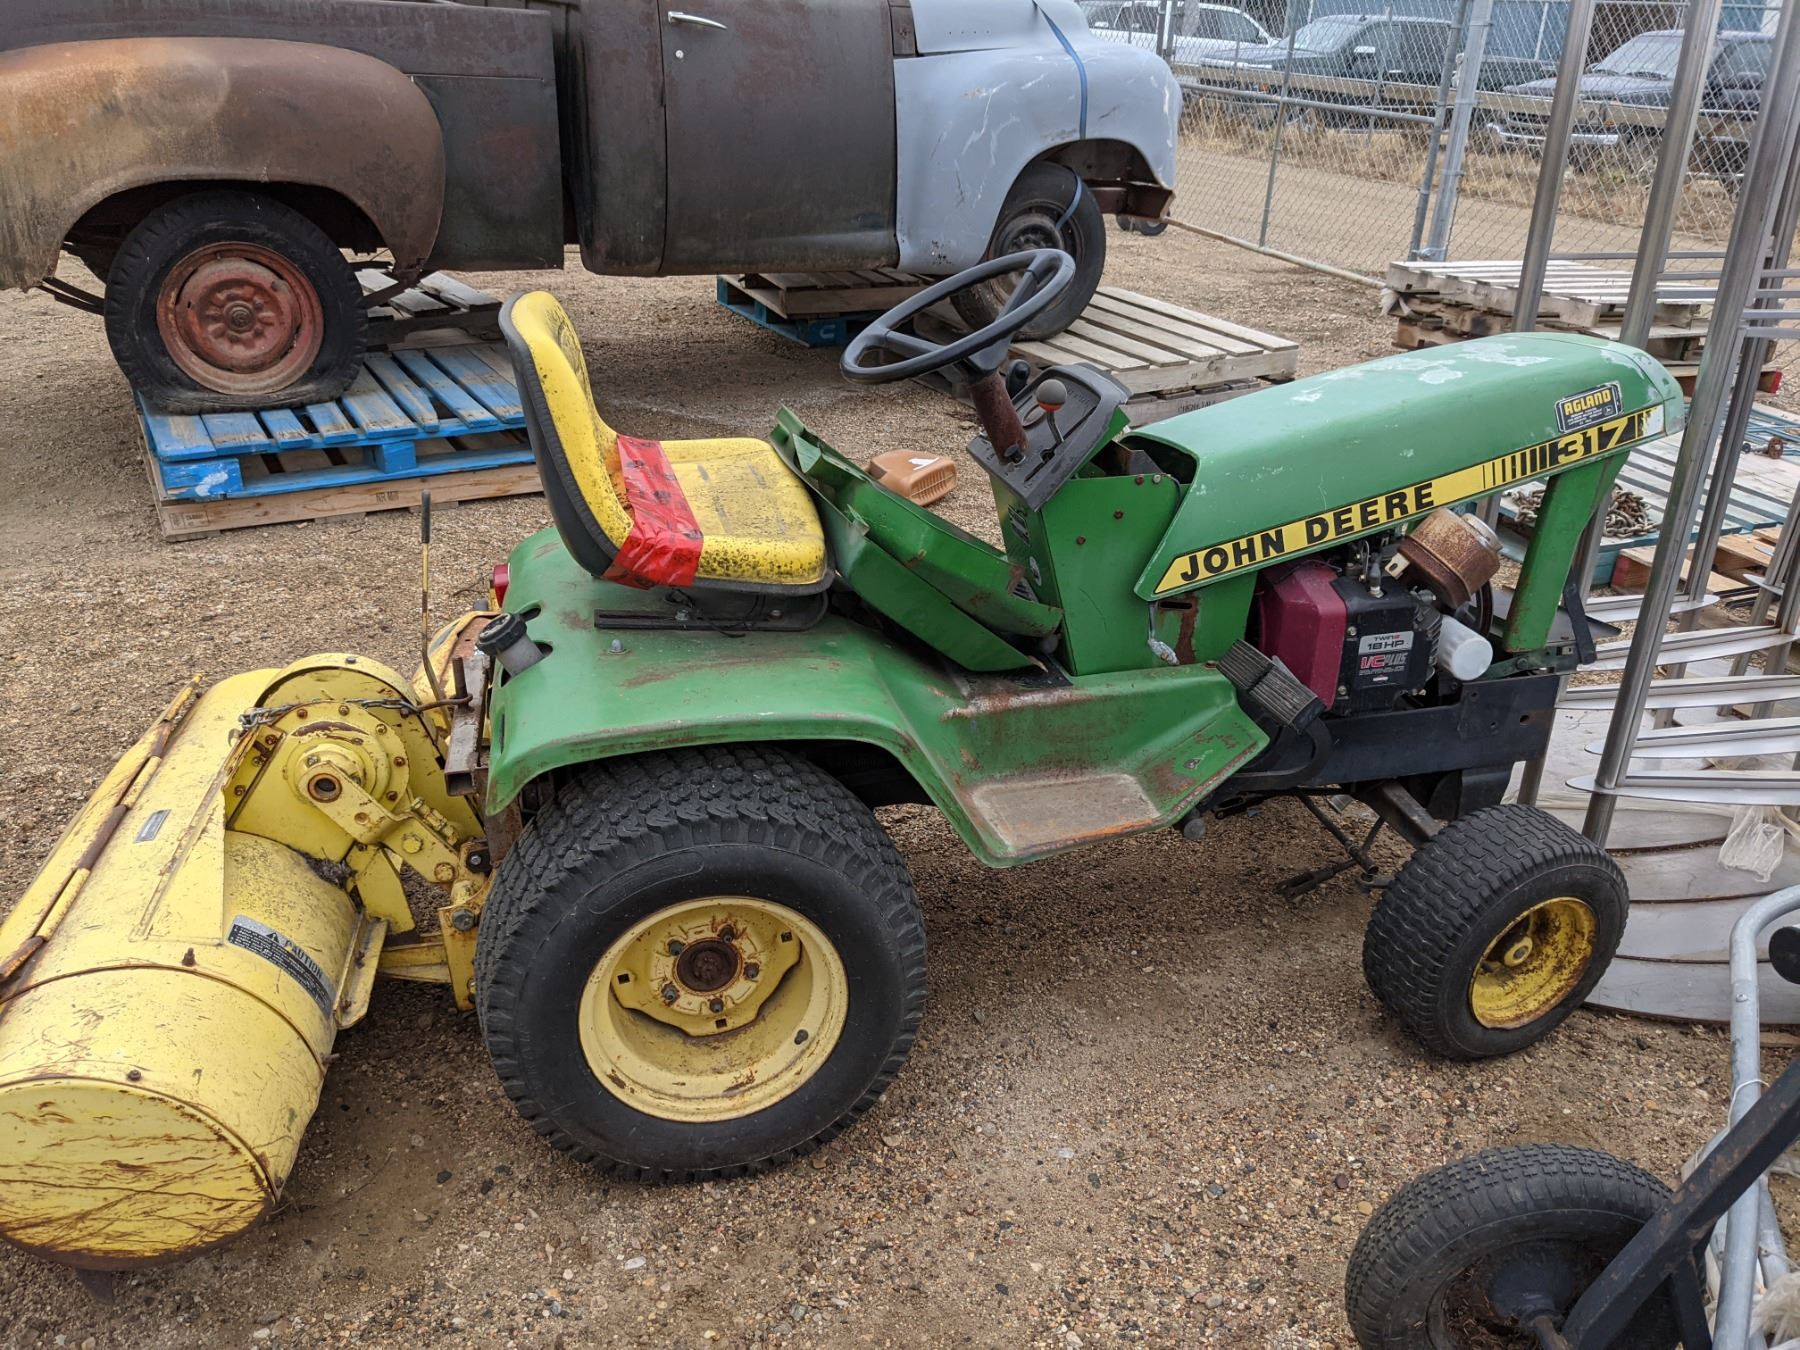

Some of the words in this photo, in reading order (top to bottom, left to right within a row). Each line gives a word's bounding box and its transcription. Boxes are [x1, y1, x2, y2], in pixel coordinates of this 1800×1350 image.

[1564, 389, 1611, 415] AGLAND
[1558, 416, 1628, 464] 317
[1180, 529, 1285, 581] JOHN
[1305, 482, 1434, 546] DEERE
[1384, 640, 1404, 649] HP
